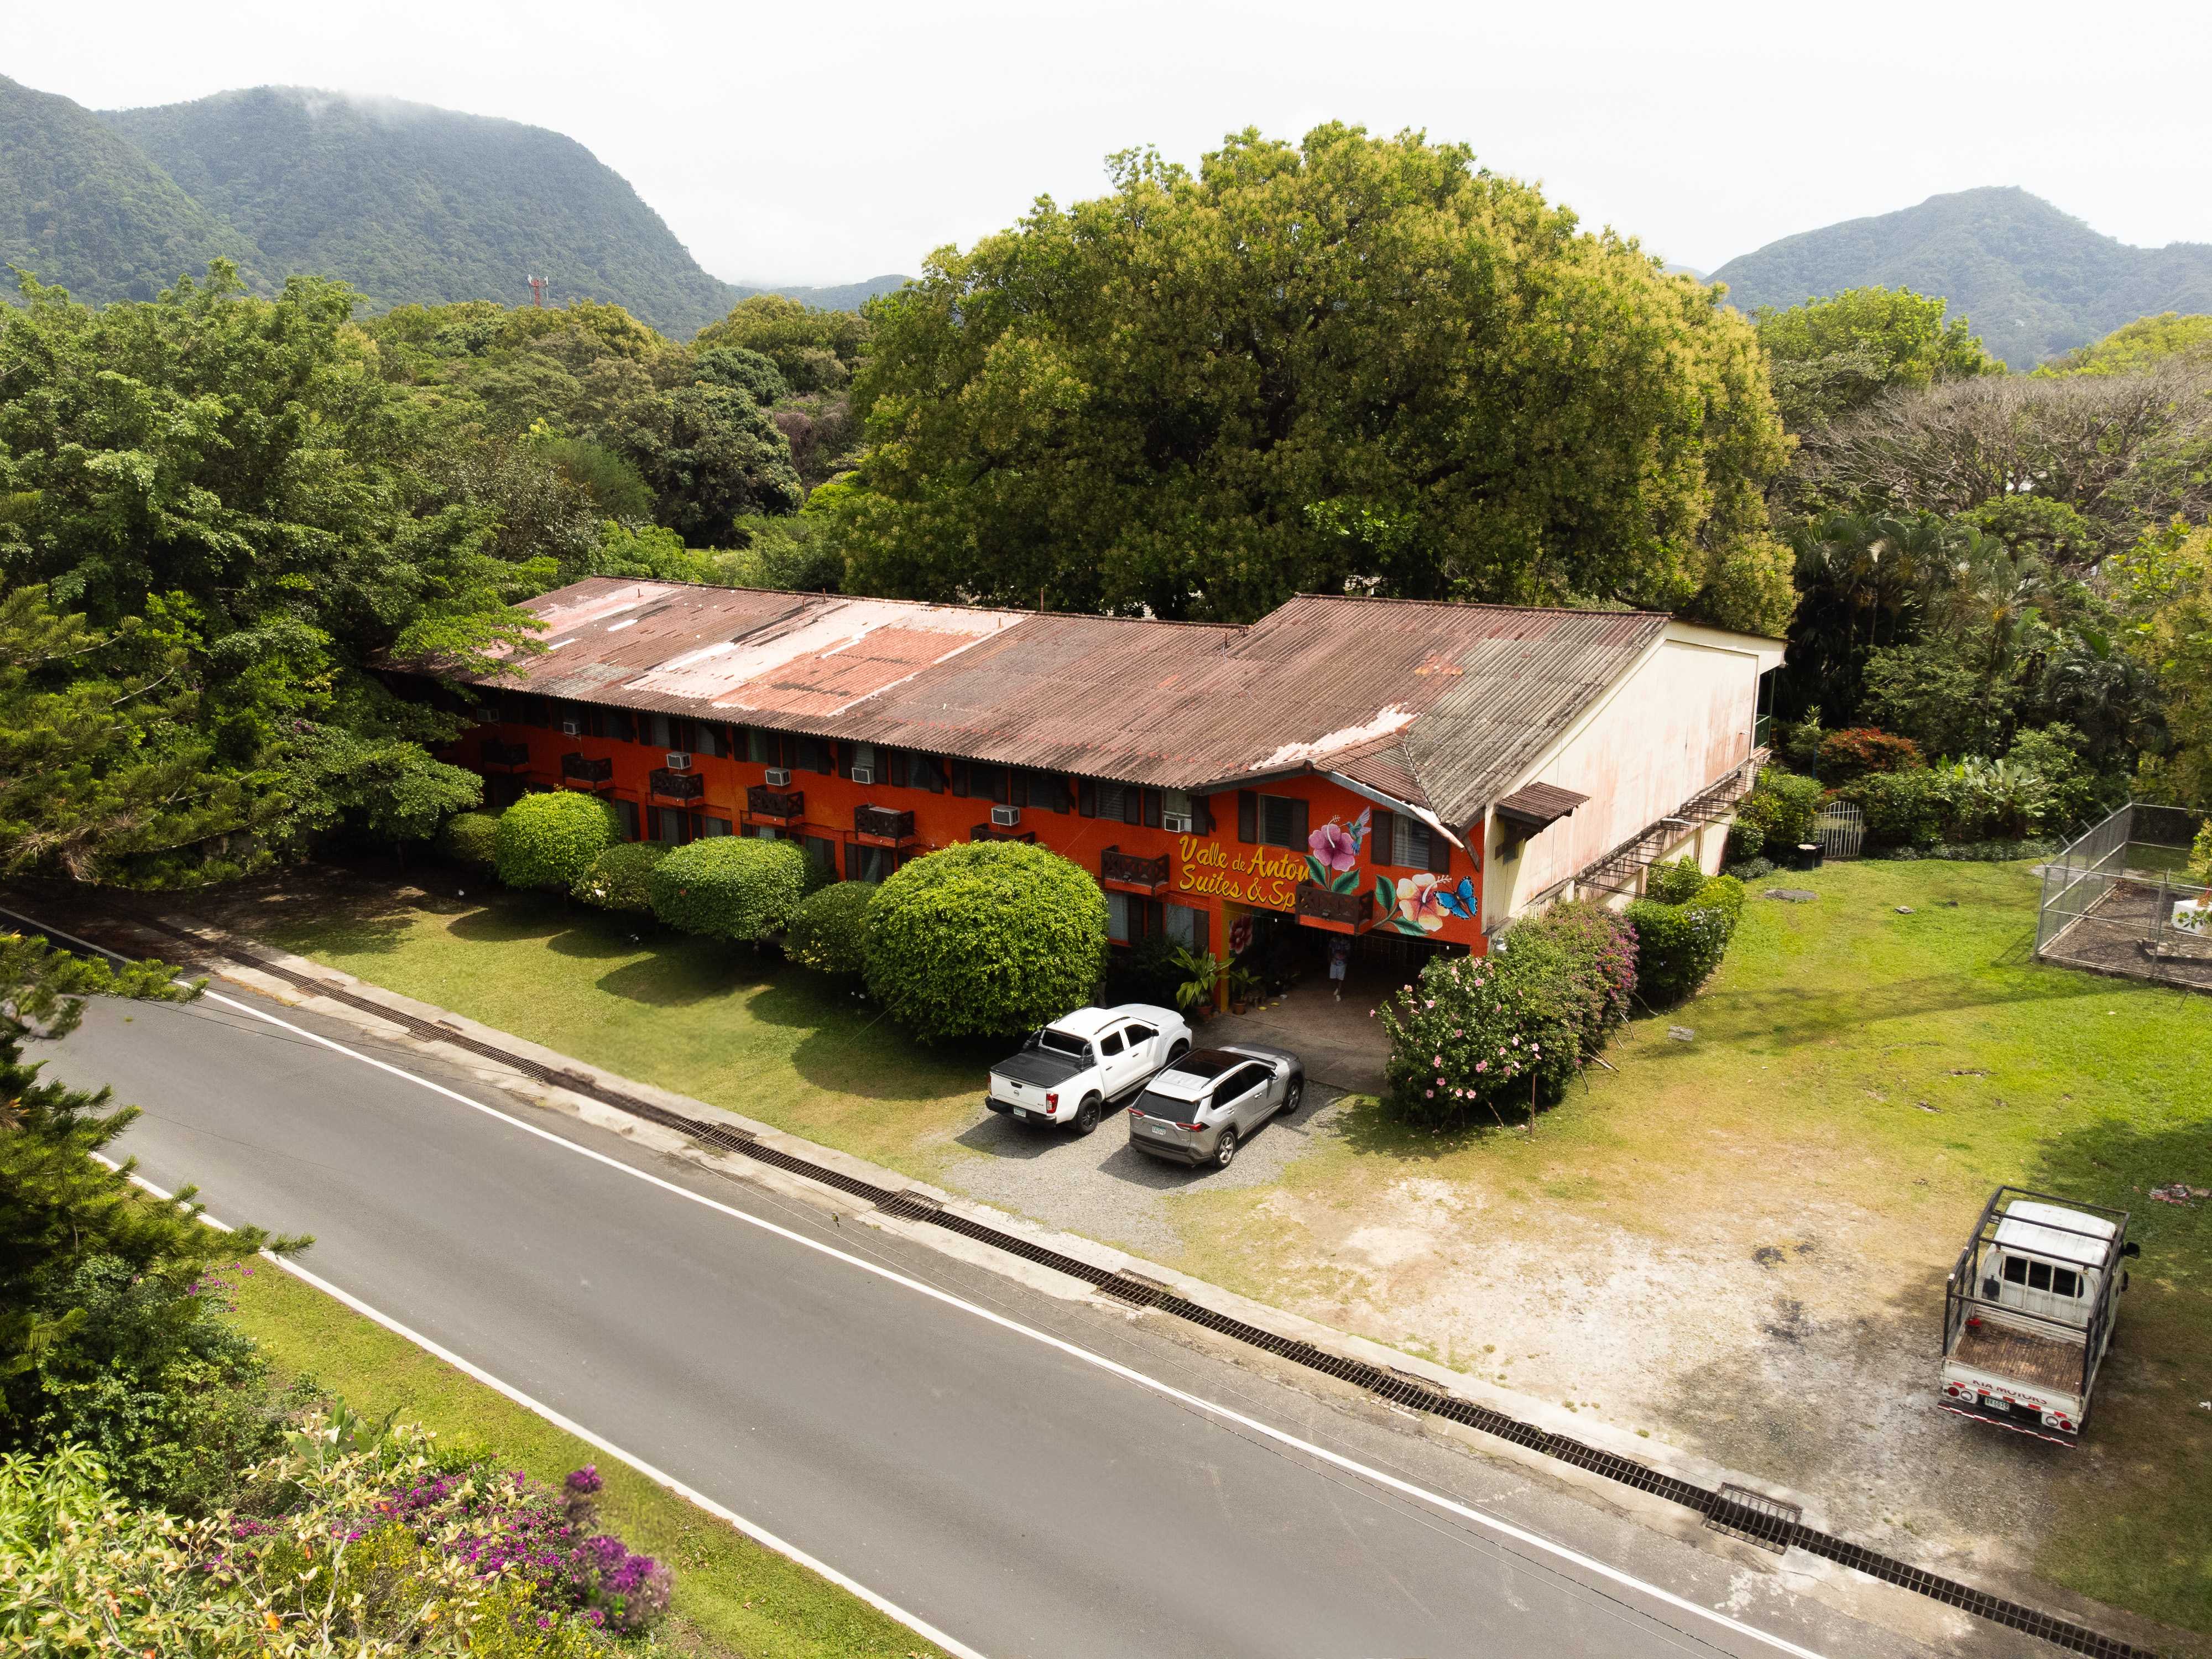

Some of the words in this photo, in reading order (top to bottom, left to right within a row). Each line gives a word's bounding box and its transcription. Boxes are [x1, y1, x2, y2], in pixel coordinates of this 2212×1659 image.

[1179, 835, 1229, 869] Valle
[1232, 853, 1246, 872] de
[1247, 846, 1310, 883] Antón
[1179, 864, 1243, 899] Suites
[1246, 877, 1267, 903] &
[1269, 880, 1296, 912] Sp
[1973, 1379, 1993, 1390] KIA
[1996, 1385, 2047, 1405] MOTORS
